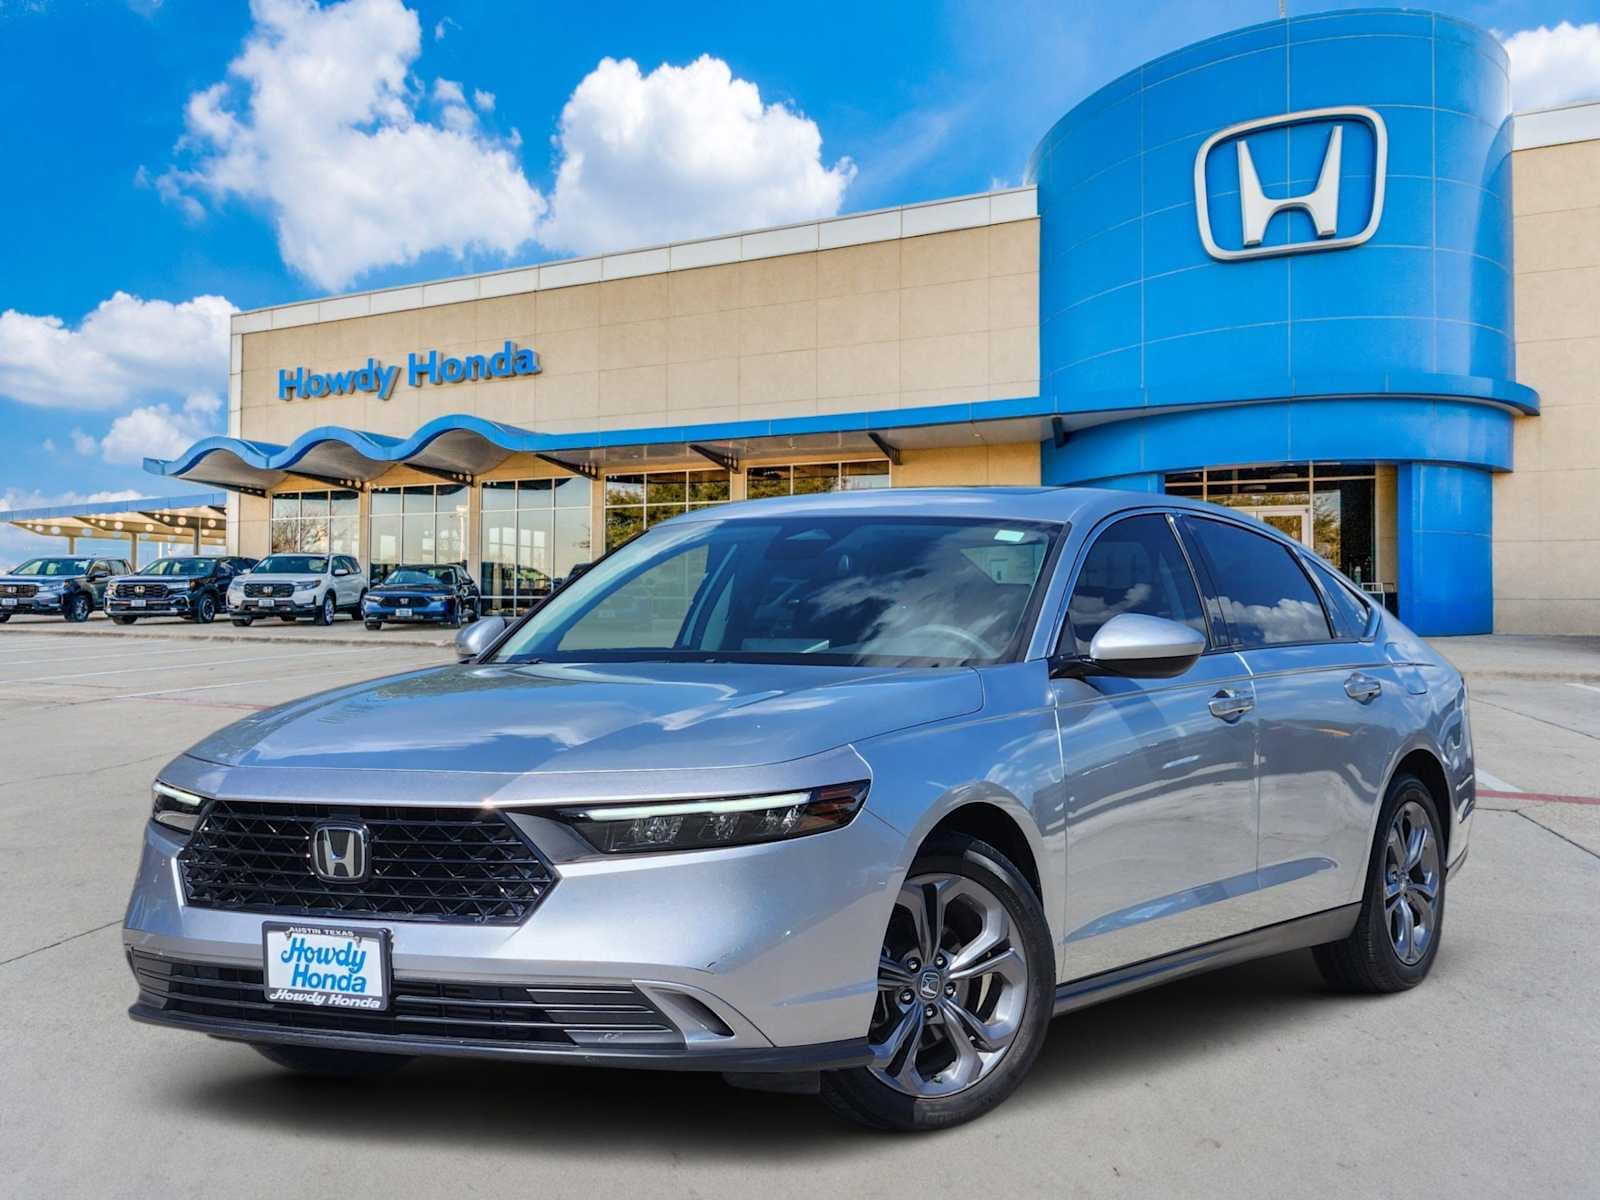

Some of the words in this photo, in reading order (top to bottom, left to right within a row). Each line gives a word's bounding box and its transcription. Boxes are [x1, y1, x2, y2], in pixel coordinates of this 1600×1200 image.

[278, 358, 400, 401] Howdy
[407, 340, 541, 388] Honda
[289, 926, 321, 935] AUSTIN
[324, 929, 354, 937] TEXAS
[281, 937, 366, 973] Howdy
[291, 964, 367, 993] Honda
[269, 989, 326, 1005] Howdy
[328, 993, 381, 1009] Honda
